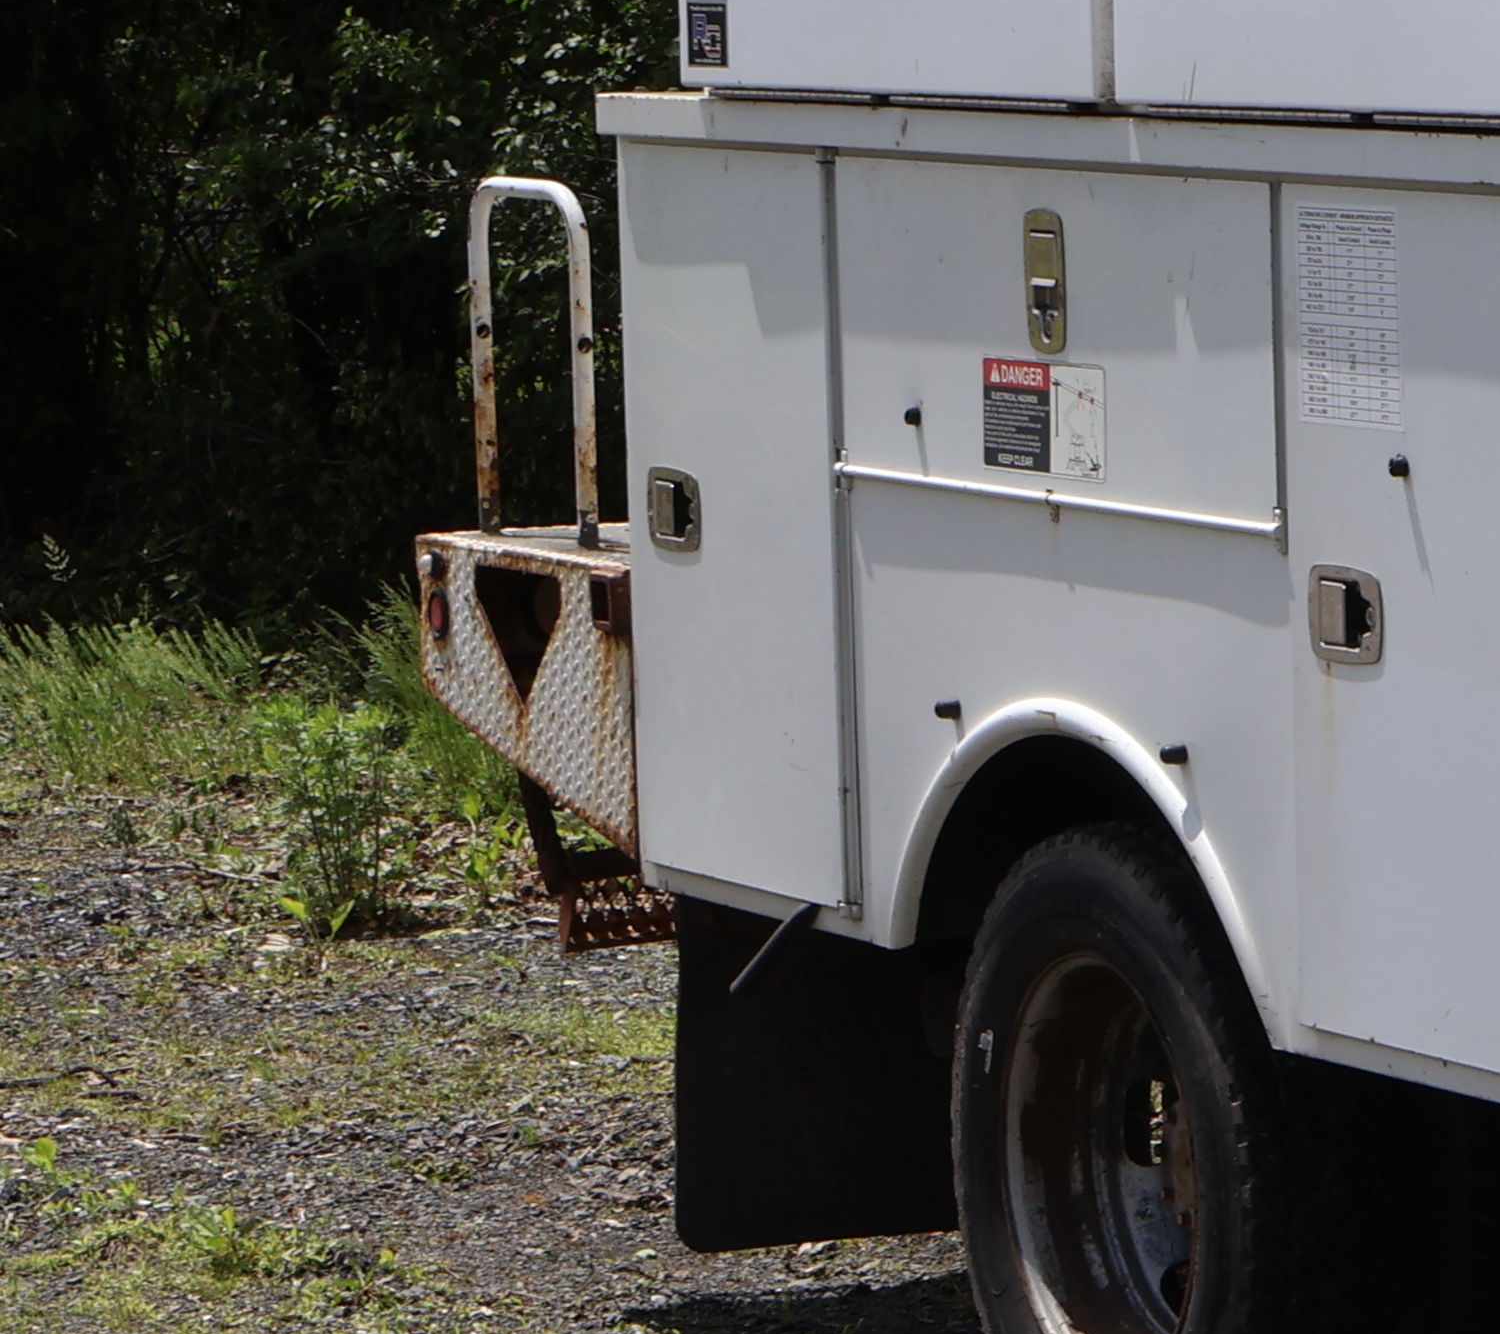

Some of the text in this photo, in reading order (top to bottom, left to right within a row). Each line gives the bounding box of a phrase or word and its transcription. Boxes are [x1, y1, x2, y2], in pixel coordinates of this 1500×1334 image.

[1001, 365, 1043, 387] DANGER
[998, 453, 1034, 467] KEEP CLEAR
